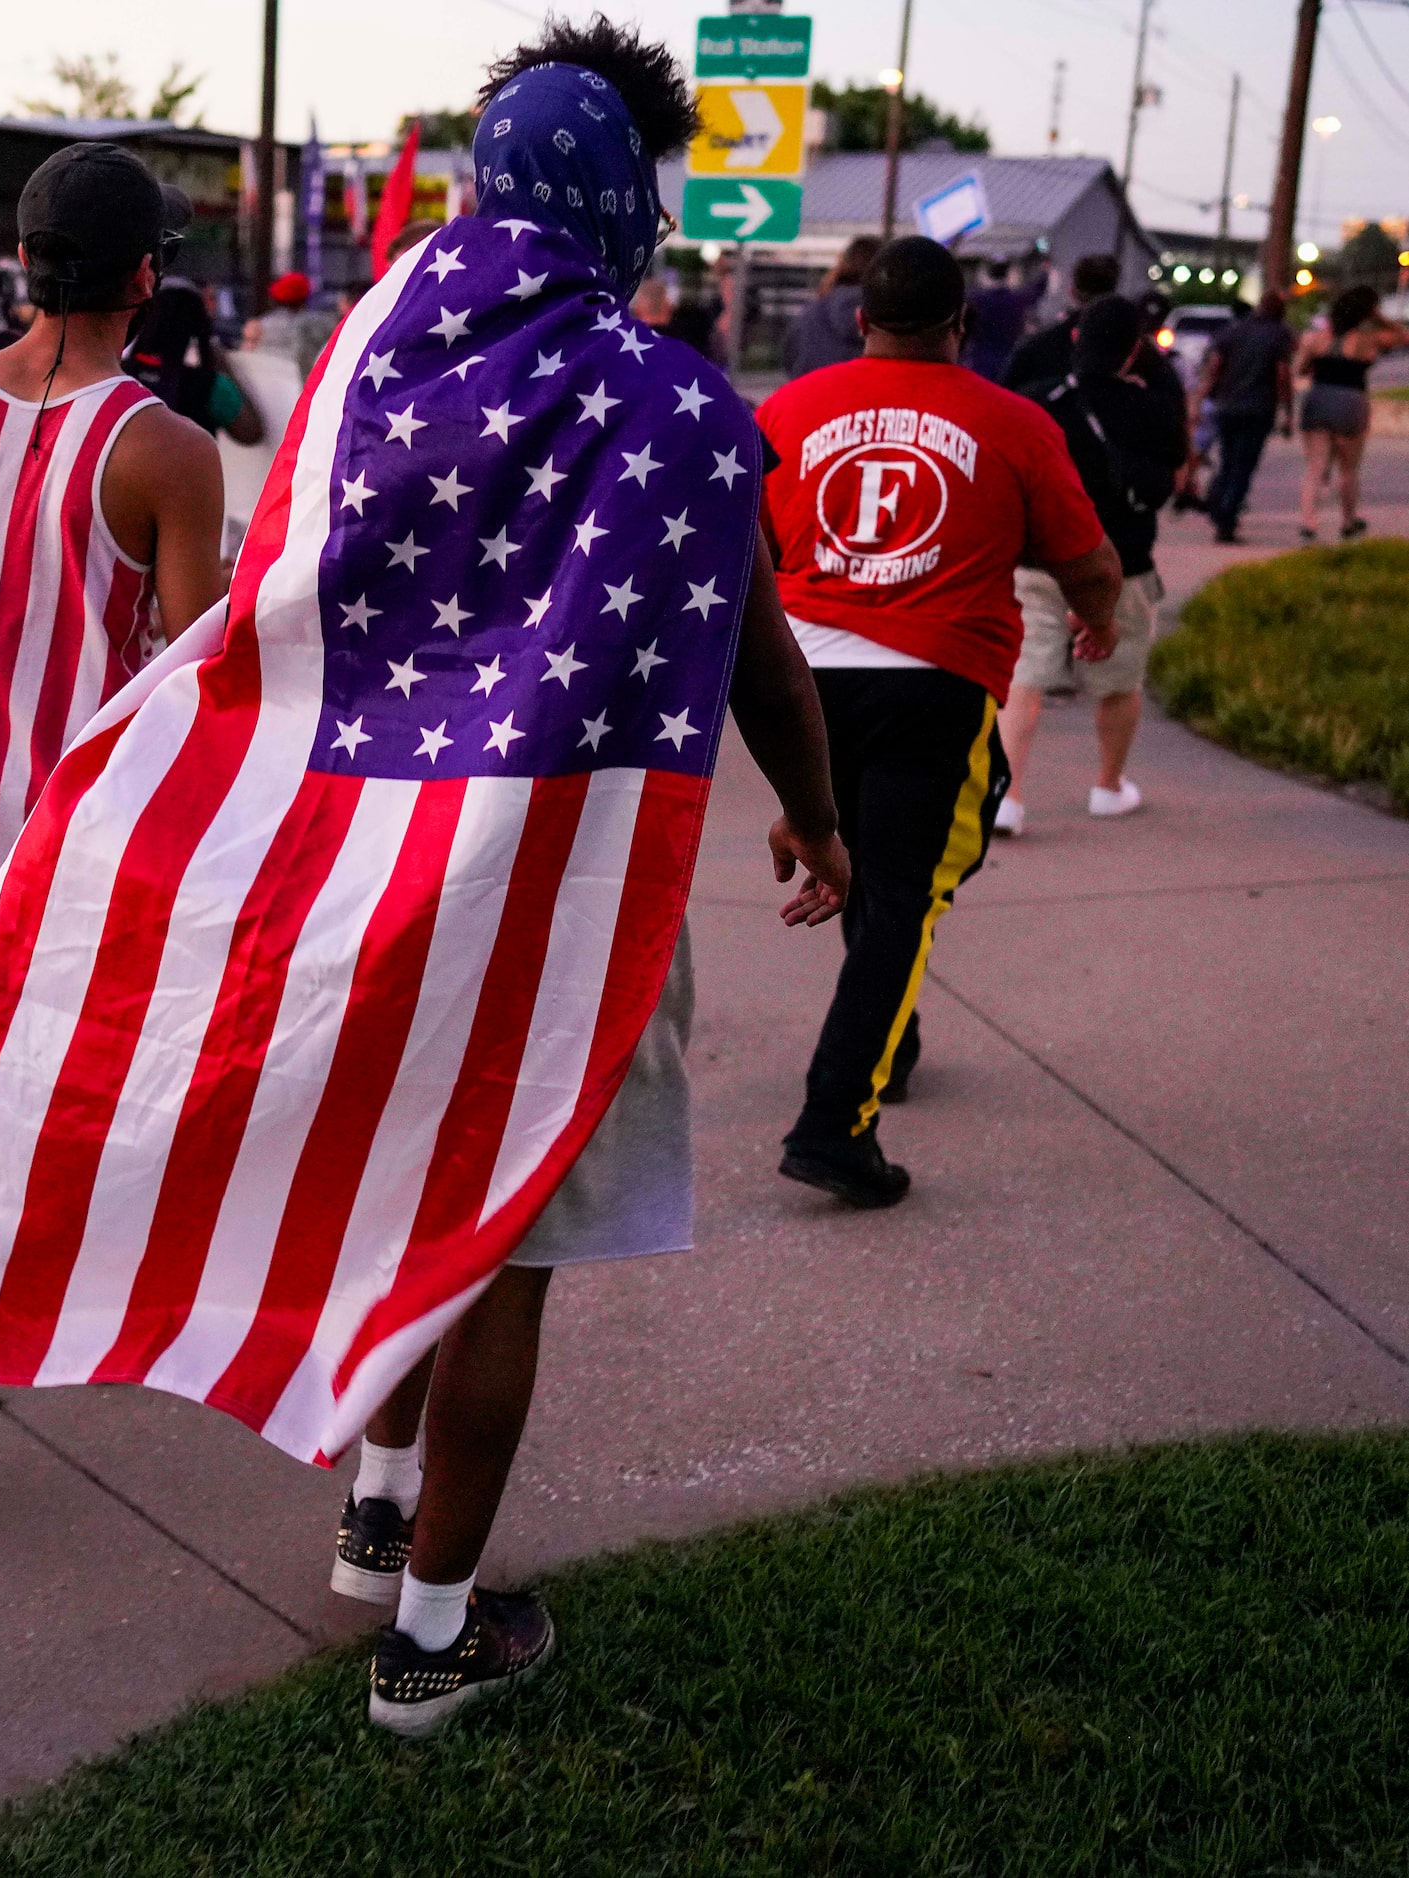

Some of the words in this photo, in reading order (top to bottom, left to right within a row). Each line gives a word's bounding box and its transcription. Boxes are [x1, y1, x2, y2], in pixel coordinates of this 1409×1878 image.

[799, 408, 877, 481] FRECKLE'S
[875, 407, 919, 444] FRIED
[918, 411, 979, 484] CHICKEN
[845, 459, 917, 543] F
[848, 543, 942, 586] CATERING
